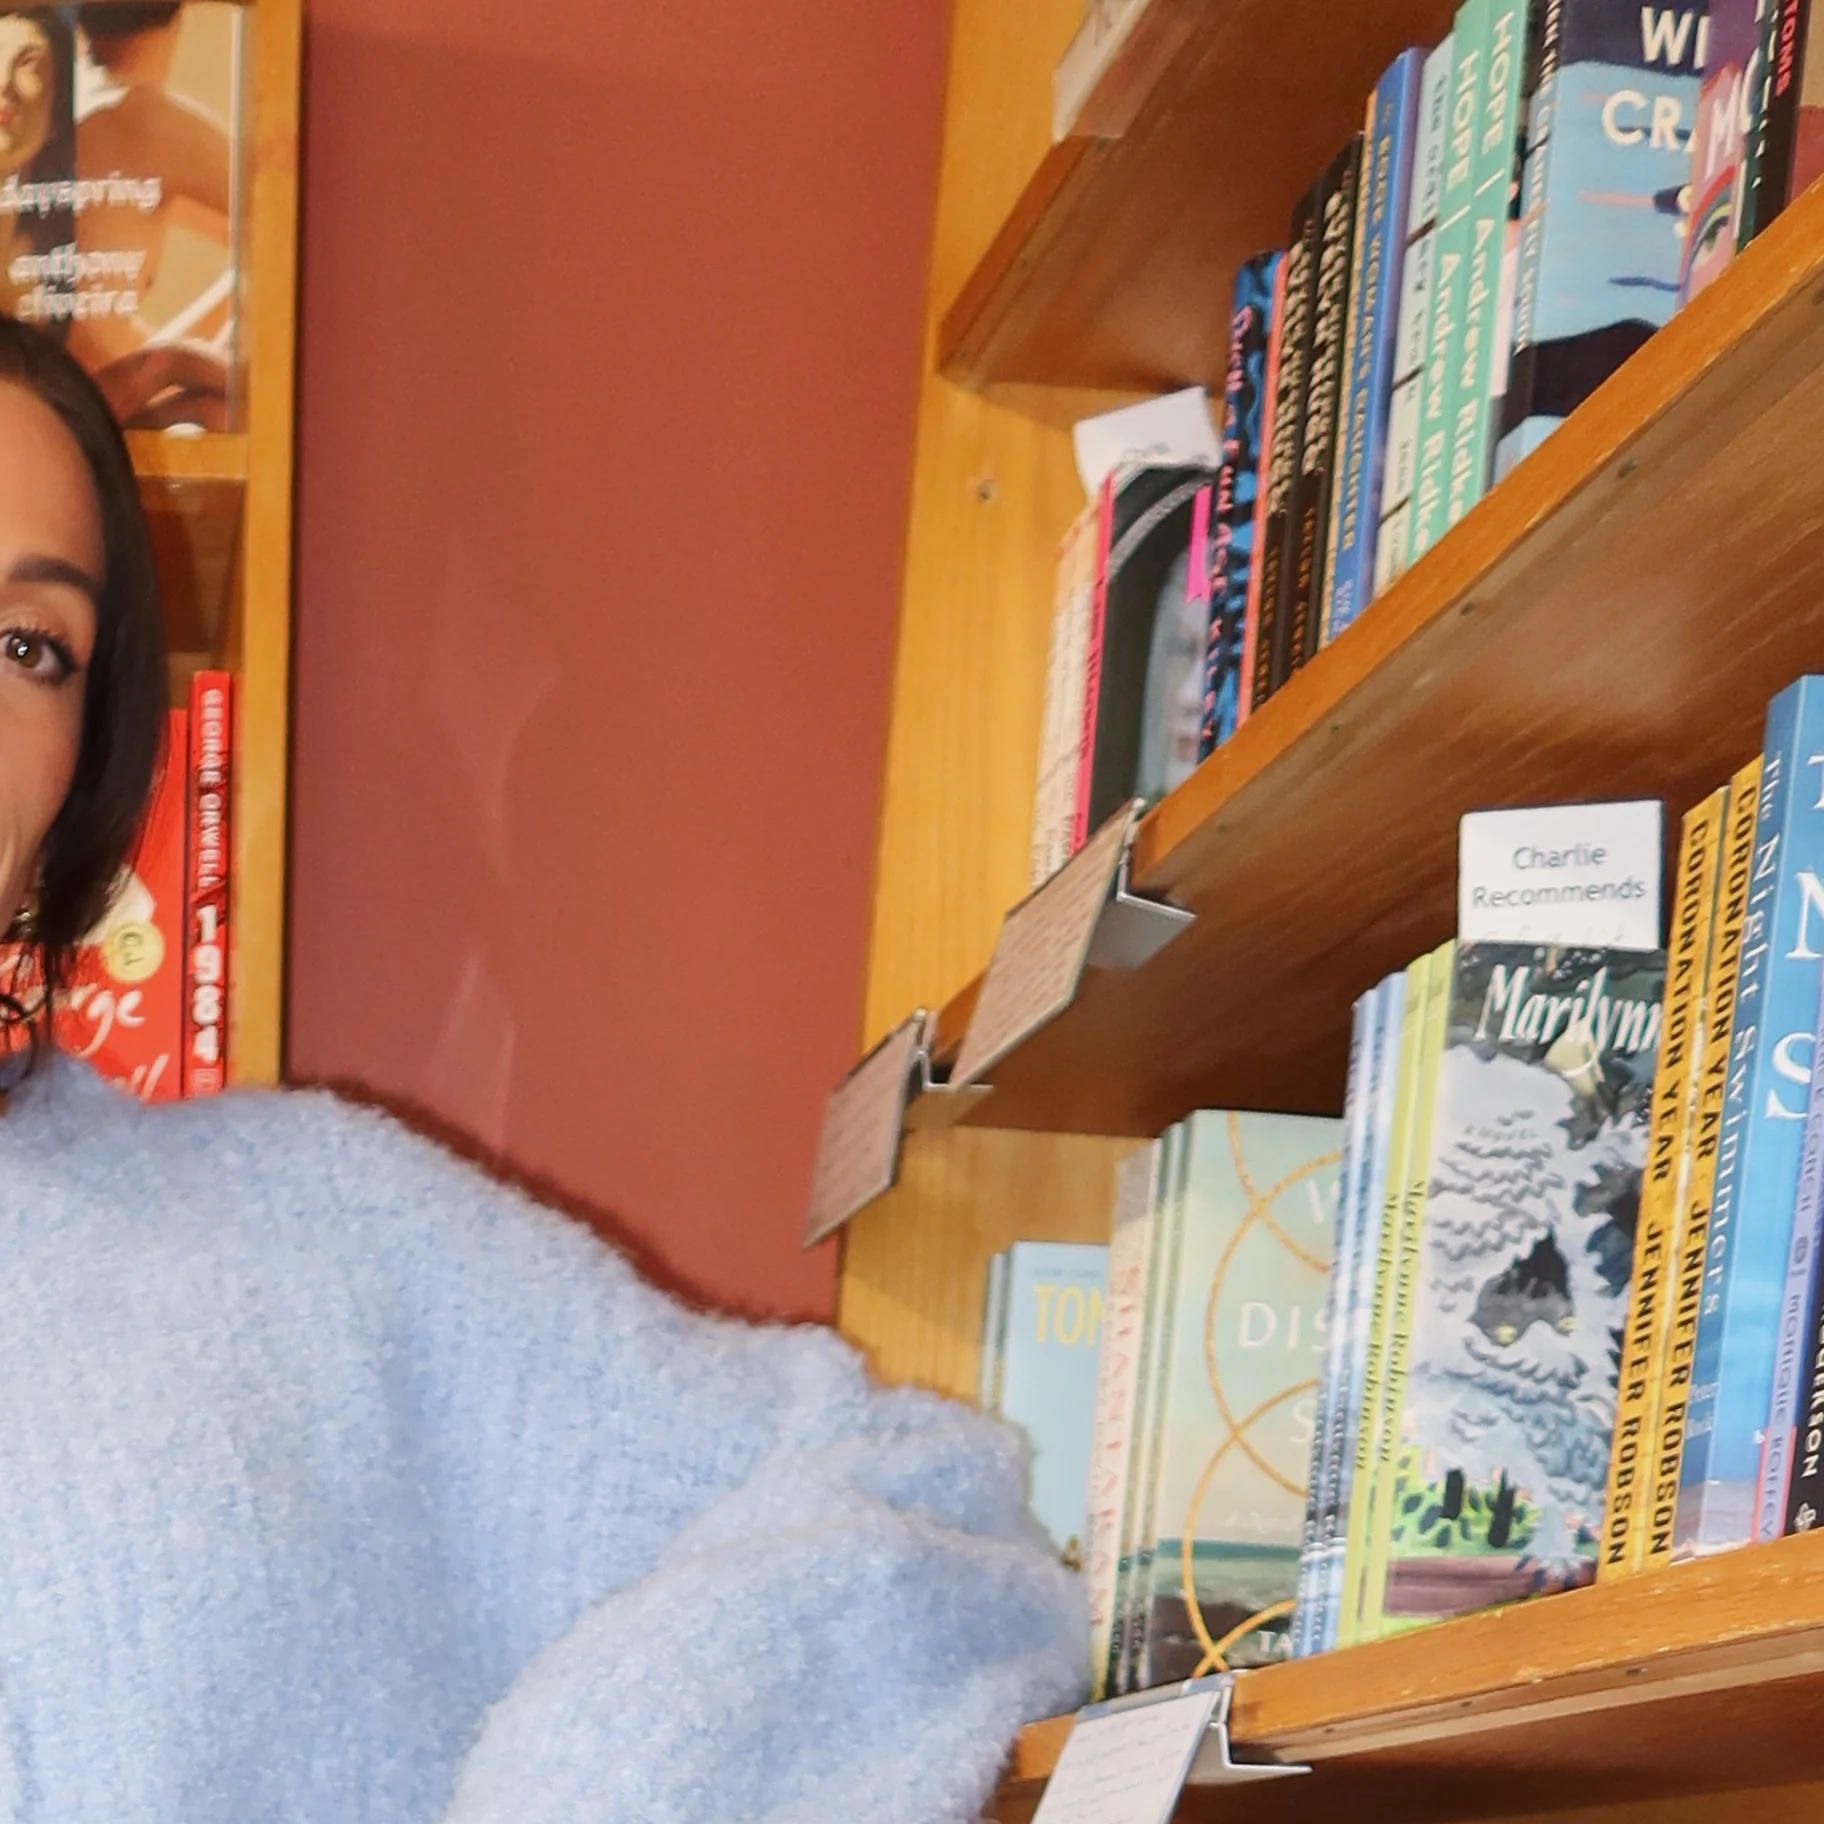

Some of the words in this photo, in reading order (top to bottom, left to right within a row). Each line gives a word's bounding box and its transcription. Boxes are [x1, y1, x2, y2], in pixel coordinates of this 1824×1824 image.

[1445, 50, 1481, 190] HOPE
[1480, 8, 1516, 157] HOPE
[9, 243, 145, 282] anthony
[18, 283, 138, 316] oliveira
[1425, 252, 1463, 422] Andrew
[1458, 216, 1494, 389] Andrew
[1472, 875, 1646, 910] Recommends
[1511, 844, 1607, 871] Charlie
[1707, 783, 1760, 1057] CORONATION
[1736, 829, 1781, 1005] Night
[192, 905, 223, 1063] 1984
[1666, 818, 1710, 1084] CORONATION
[1649, 1091, 1686, 1185] YEAR
[1692, 1063, 1730, 1164] YEAR
[1703, 1025, 1754, 1318] Swimmers
[1367, 1193, 1401, 1349] Marilynne
[1390, 1179, 1427, 1353] Marilynne
[1622, 1216, 1660, 1405] JENNIFER
[1668, 1197, 1710, 1388] JENNIFER
[1352, 1358, 1380, 1472] Robinson
[1376, 1354, 1404, 1465] Robinson
[1648, 1401, 1688, 1560] ROBSON
[1604, 1414, 1643, 1567] ROBSON
